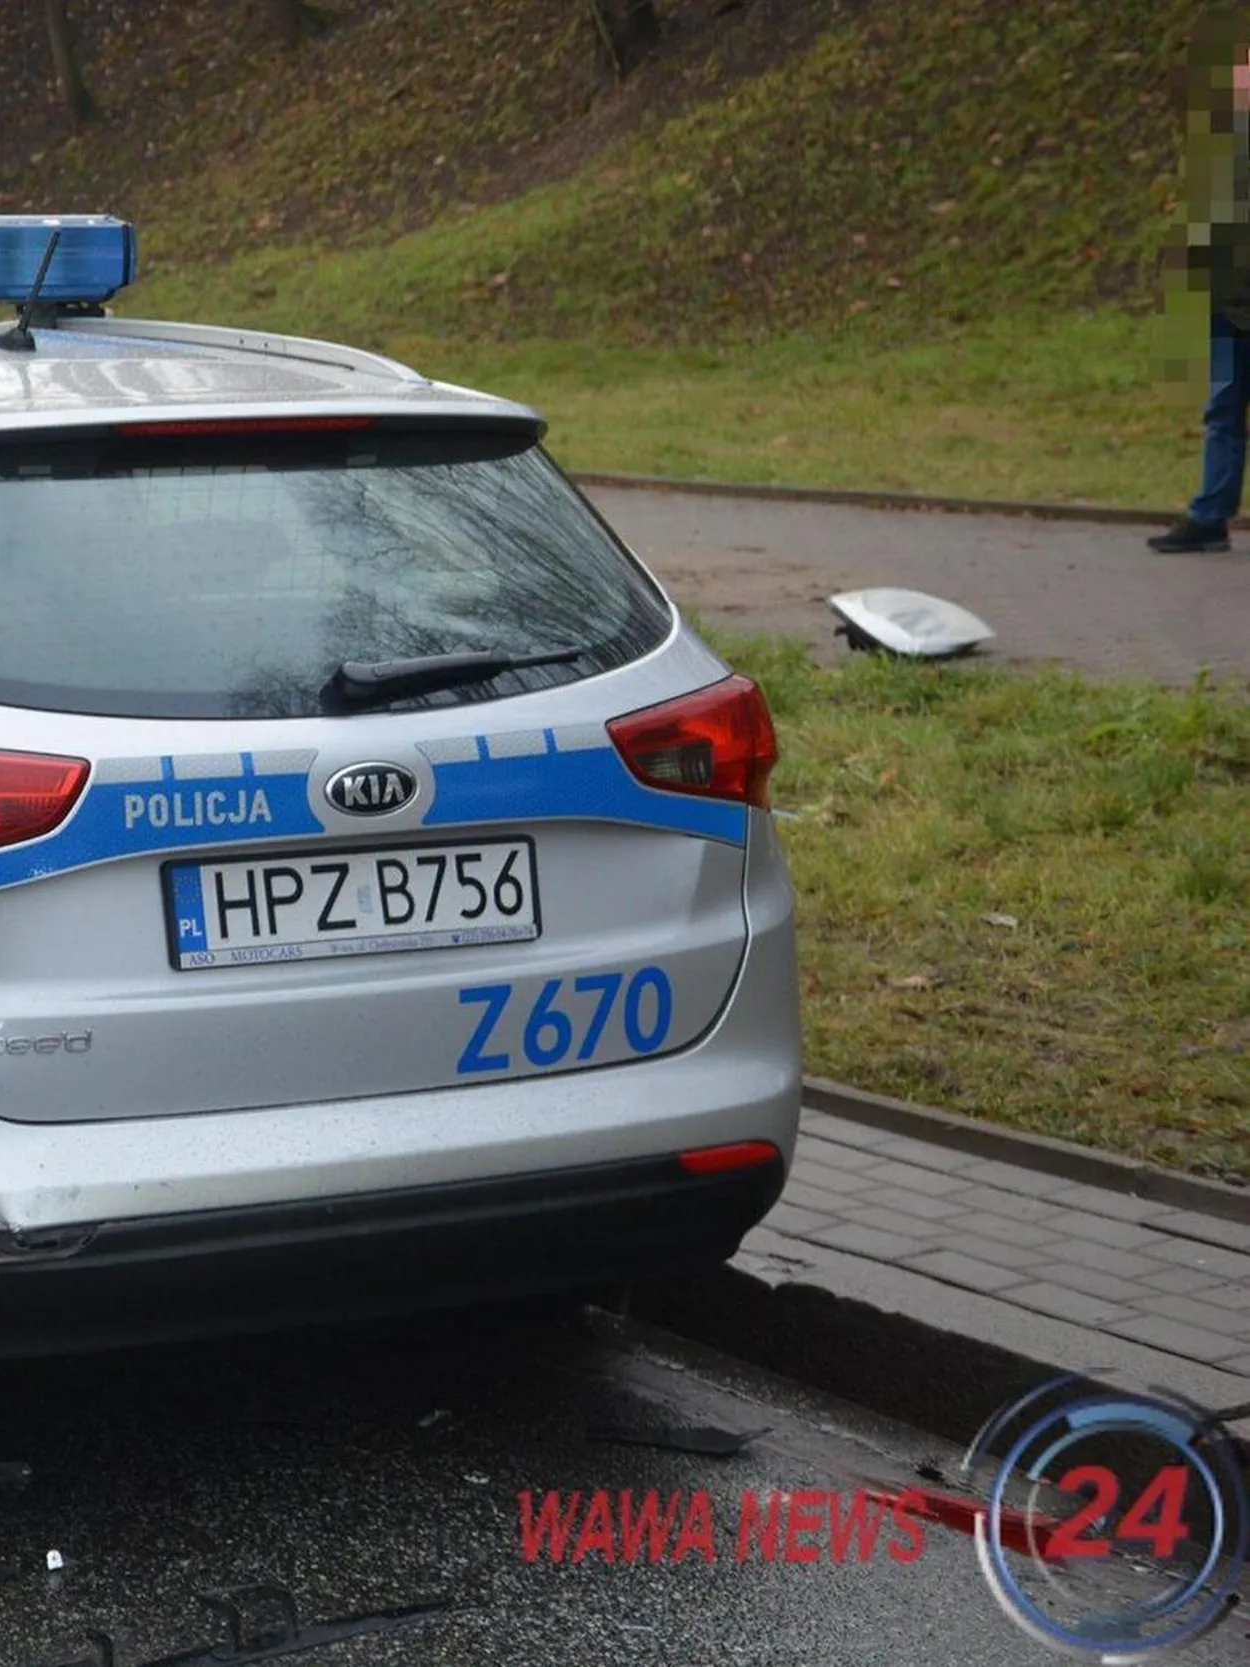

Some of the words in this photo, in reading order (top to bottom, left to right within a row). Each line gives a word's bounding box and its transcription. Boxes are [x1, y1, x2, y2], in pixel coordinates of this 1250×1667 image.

[343, 773, 406, 807] KIA
[125, 789, 273, 828] POLICJA
[215, 862, 357, 939] HPZ
[376, 850, 524, 926] B756
[180, 919, 202, 938] PL
[189, 952, 216, 965] ASO
[456, 965, 672, 1075] Z670
